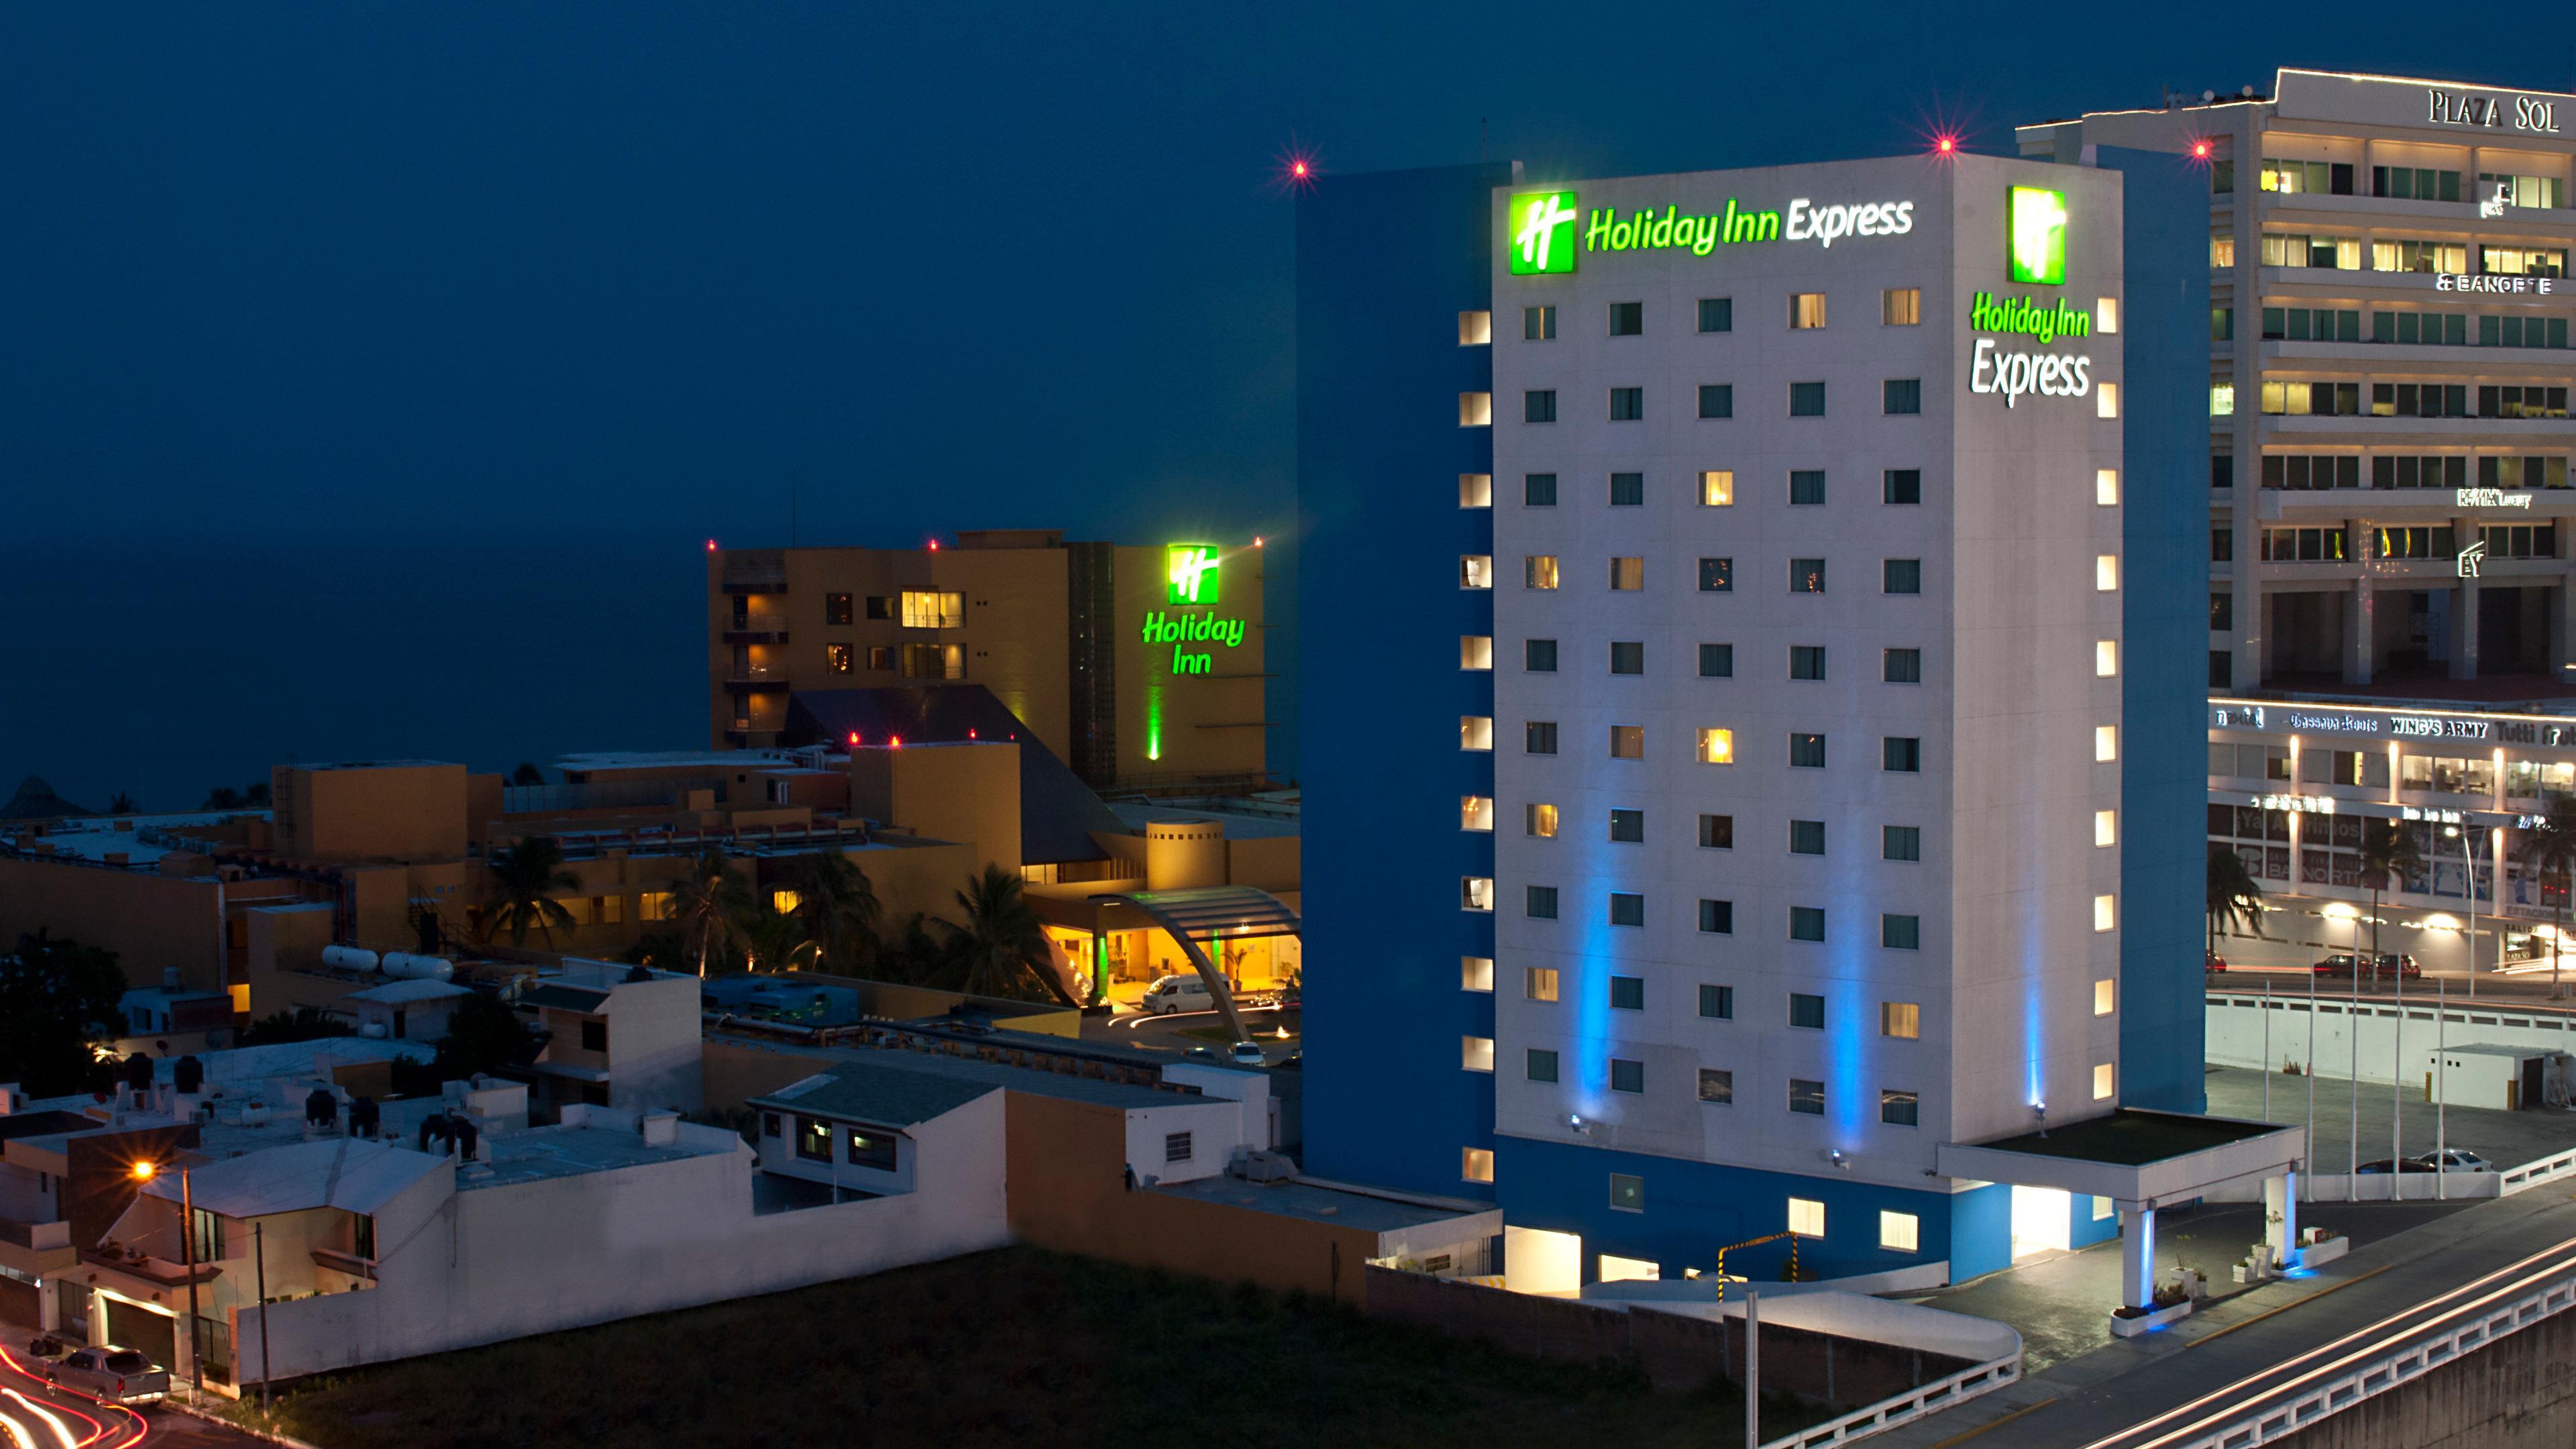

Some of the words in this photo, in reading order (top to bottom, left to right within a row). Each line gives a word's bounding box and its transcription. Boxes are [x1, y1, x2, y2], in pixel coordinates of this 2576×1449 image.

[2428, 89, 2503, 127] PLAZA
[2516, 96, 2560, 131] SOL
[1585, 205, 1718, 256] Holiday
[1724, 198, 1779, 244] Inn
[1786, 198, 1914, 248] Express
[1972, 292, 2055, 343] Holiday
[2055, 298, 2090, 337] Inn
[1972, 339, 2090, 408] Express
[2459, 553, 2484, 578] EY
[1142, 611, 1245, 647] Holiday
[1172, 644, 1212, 675] Inn
[2391, 717, 2443, 737] WING'S
[2445, 721, 2488, 739] ARMY
[2494, 721, 2535, 743] Tutti
